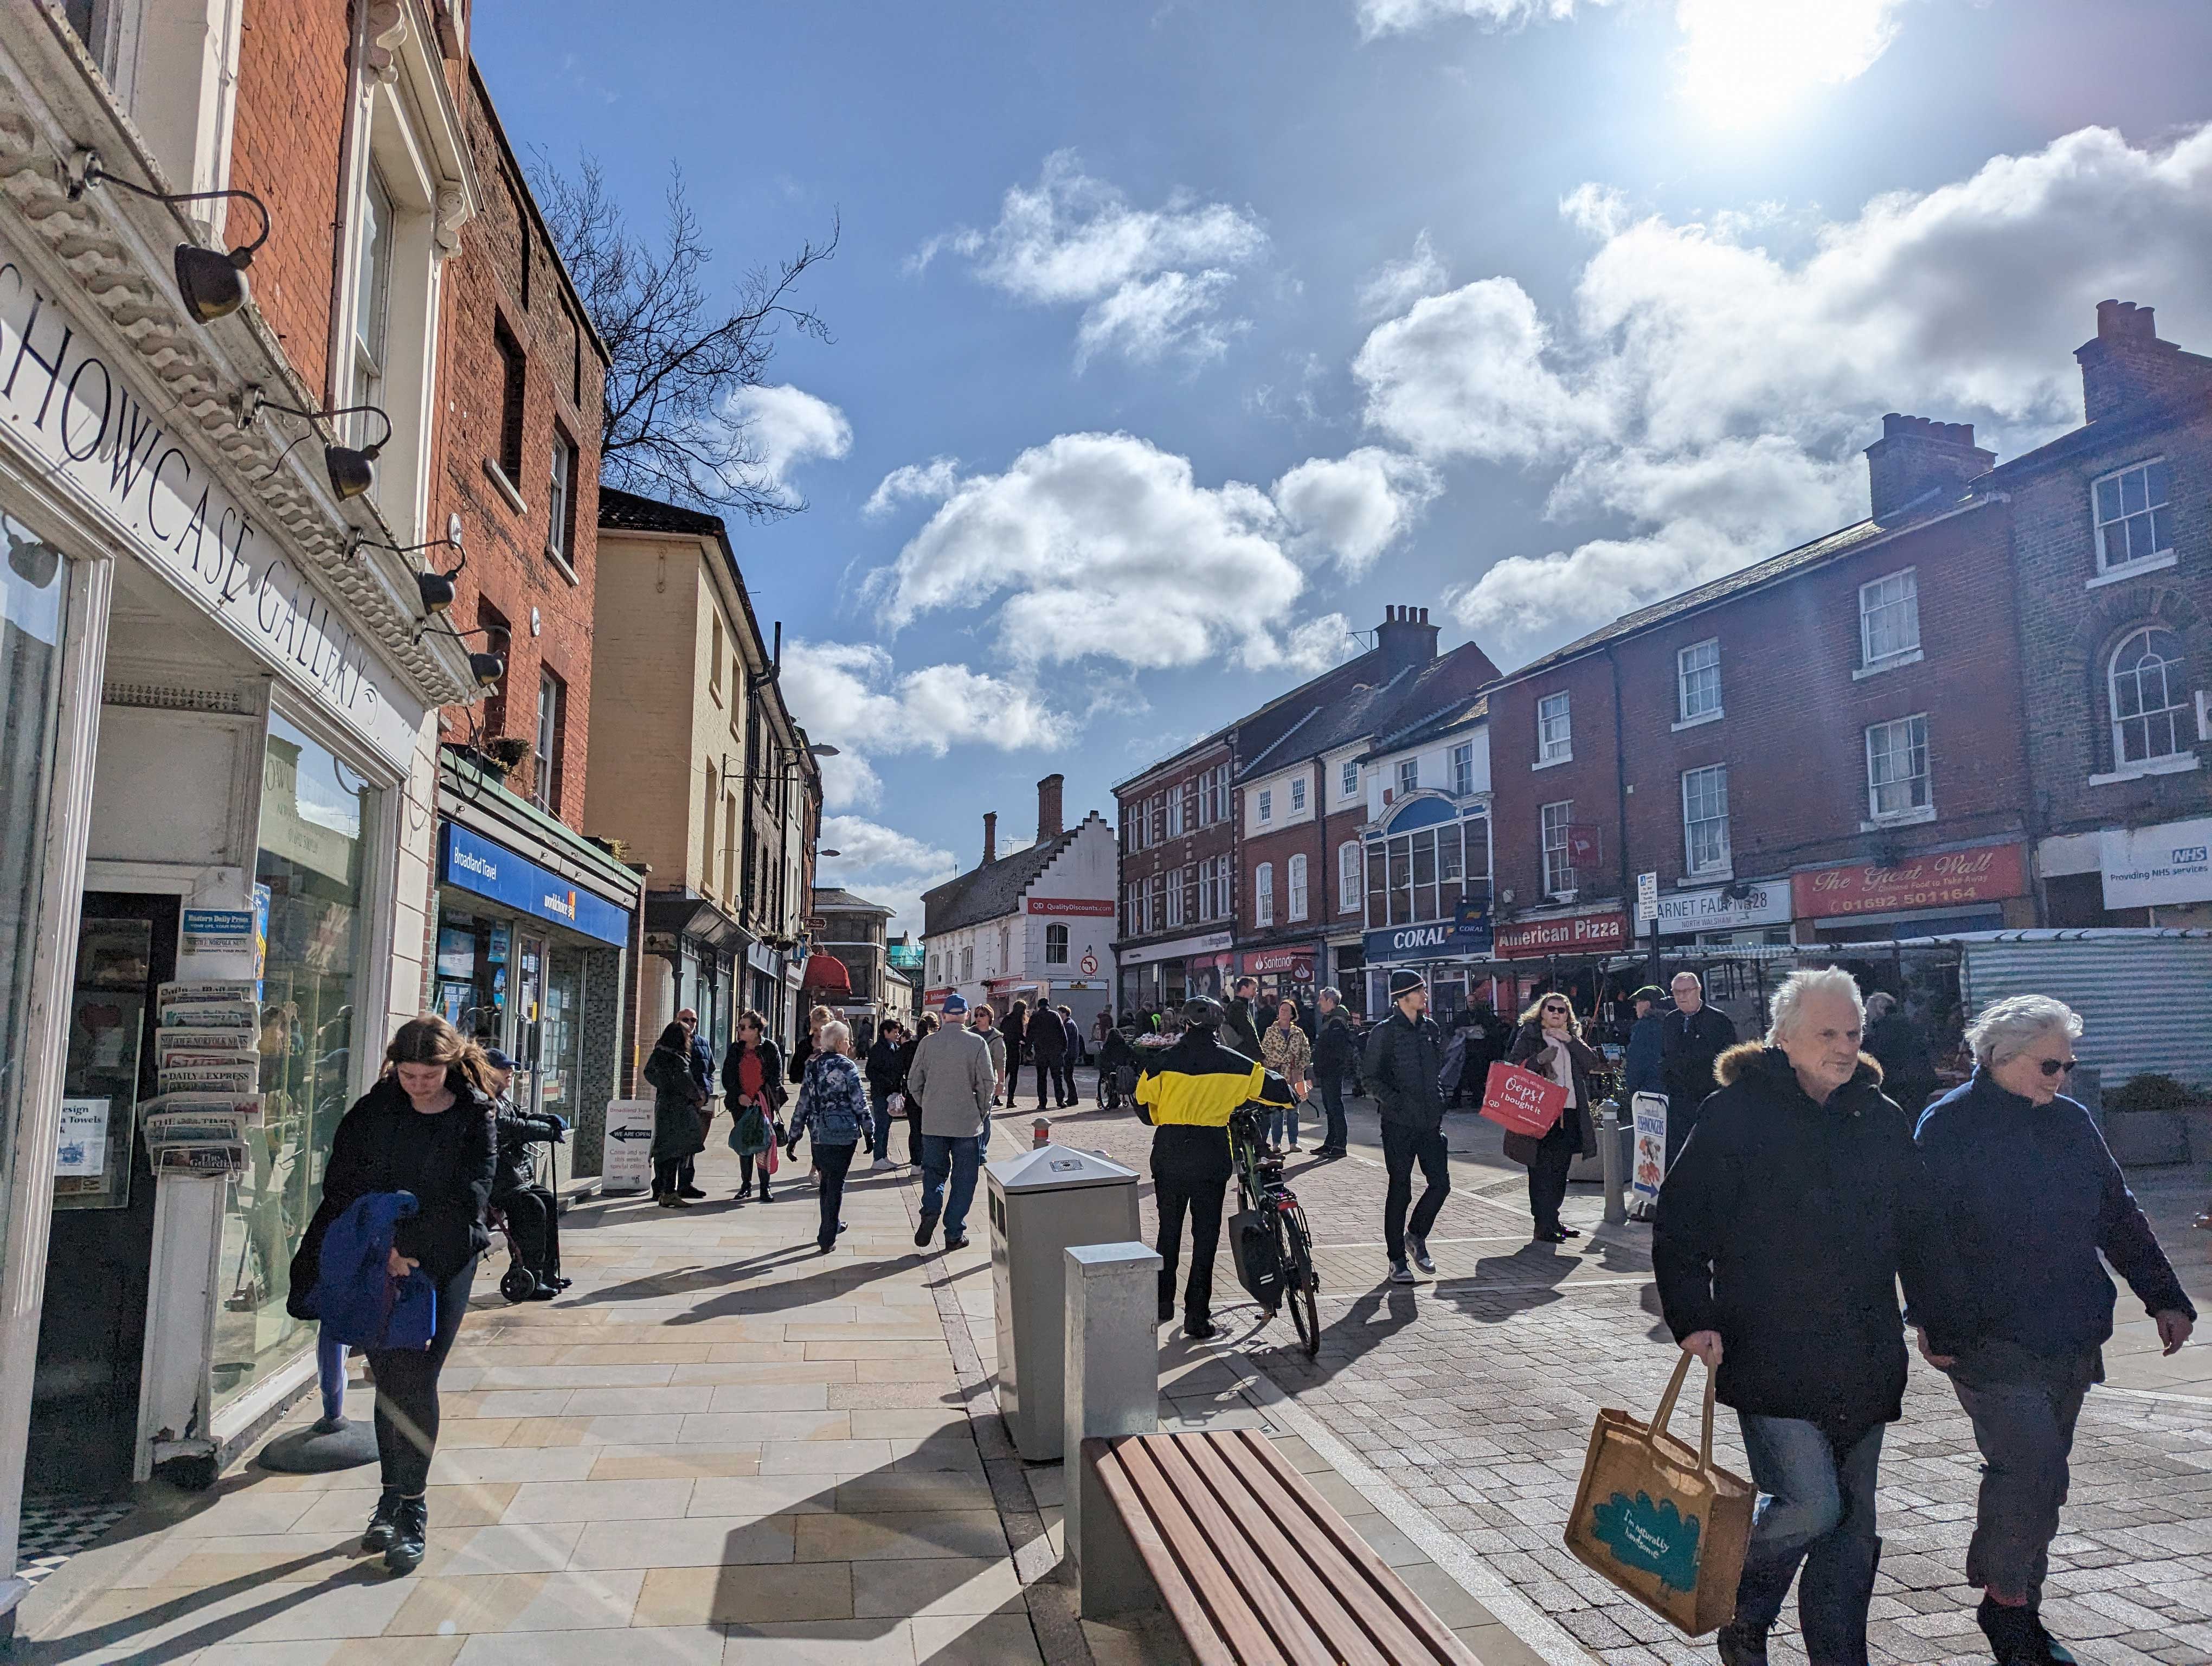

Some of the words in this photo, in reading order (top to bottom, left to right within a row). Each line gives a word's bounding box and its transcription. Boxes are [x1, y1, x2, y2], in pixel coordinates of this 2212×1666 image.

[258, 560, 369, 709] GALLERY
[454, 847, 482, 873] Broadland
[482, 858, 497, 880] Travel
[2174, 847, 2205, 862] NHS
[1813, 872, 1851, 892] The
[1861, 865, 1922, 891] Great
[1934, 853, 1993, 875] Wall
[1911, 880, 1930, 889] Food
[1964, 875, 1988, 884] Away
[2111, 870, 2150, 881] Providing
[2152, 868, 2170, 877] NHS
[2172, 864, 2208, 875] services
[1047, 904, 1111, 912] QualityDiscounts.com
[1657, 900, 1696, 918] ARNET
[1843, 896, 1896, 912] 01692
[1904, 887, 1977, 904] 501164
[1682, 919, 1700, 928] NORTH
[1701, 916, 1731, 926] WALSHAM
[1393, 926, 1445, 949] CORAL
[1499, 925, 1569, 947] American
[1575, 919, 1619, 939] Pizza
[1264, 955, 1294, 969] Santand
[169, 1072, 197, 1080] DAILY
[1506, 1077, 1545, 1104] Oops!
[62, 1105, 88, 1115] esign
[1505, 1093, 1533, 1111] bought
[1534, 1106, 1541, 1115] it
[1637, 1115, 1664, 1136] FISHMONGERS
[1624, 1508, 1634, 1528] I'm
[1635, 1524, 1670, 1553] naturally
[1625, 1526, 1660, 1559] handsome
